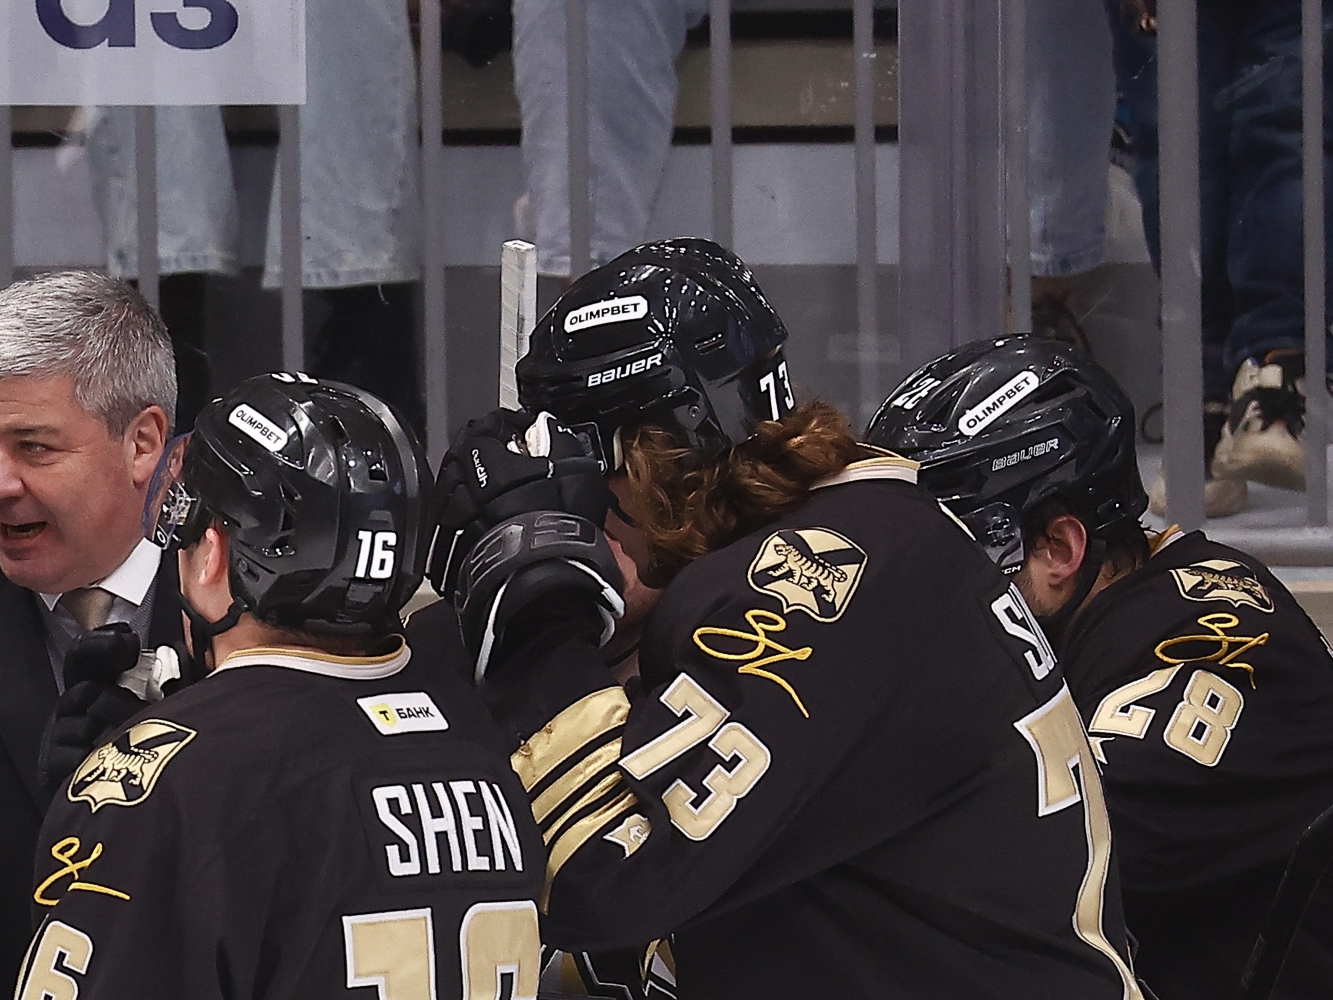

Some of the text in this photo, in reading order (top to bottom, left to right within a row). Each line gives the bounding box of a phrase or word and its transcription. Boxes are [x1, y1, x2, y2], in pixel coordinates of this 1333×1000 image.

[569, 302, 641, 326] OLIMPBET
[759, 360, 795, 421] 73
[965, 375, 1032, 430] OLIMPBET
[235, 409, 282, 446] OLIMPBET
[354, 530, 398, 580] 16
[991, 581, 1059, 681] S
[395, 706, 435, 719] БАНК
[1088, 662, 1245, 767] 28
[618, 671, 772, 842] 73
[371, 780, 525, 878] SHEN
